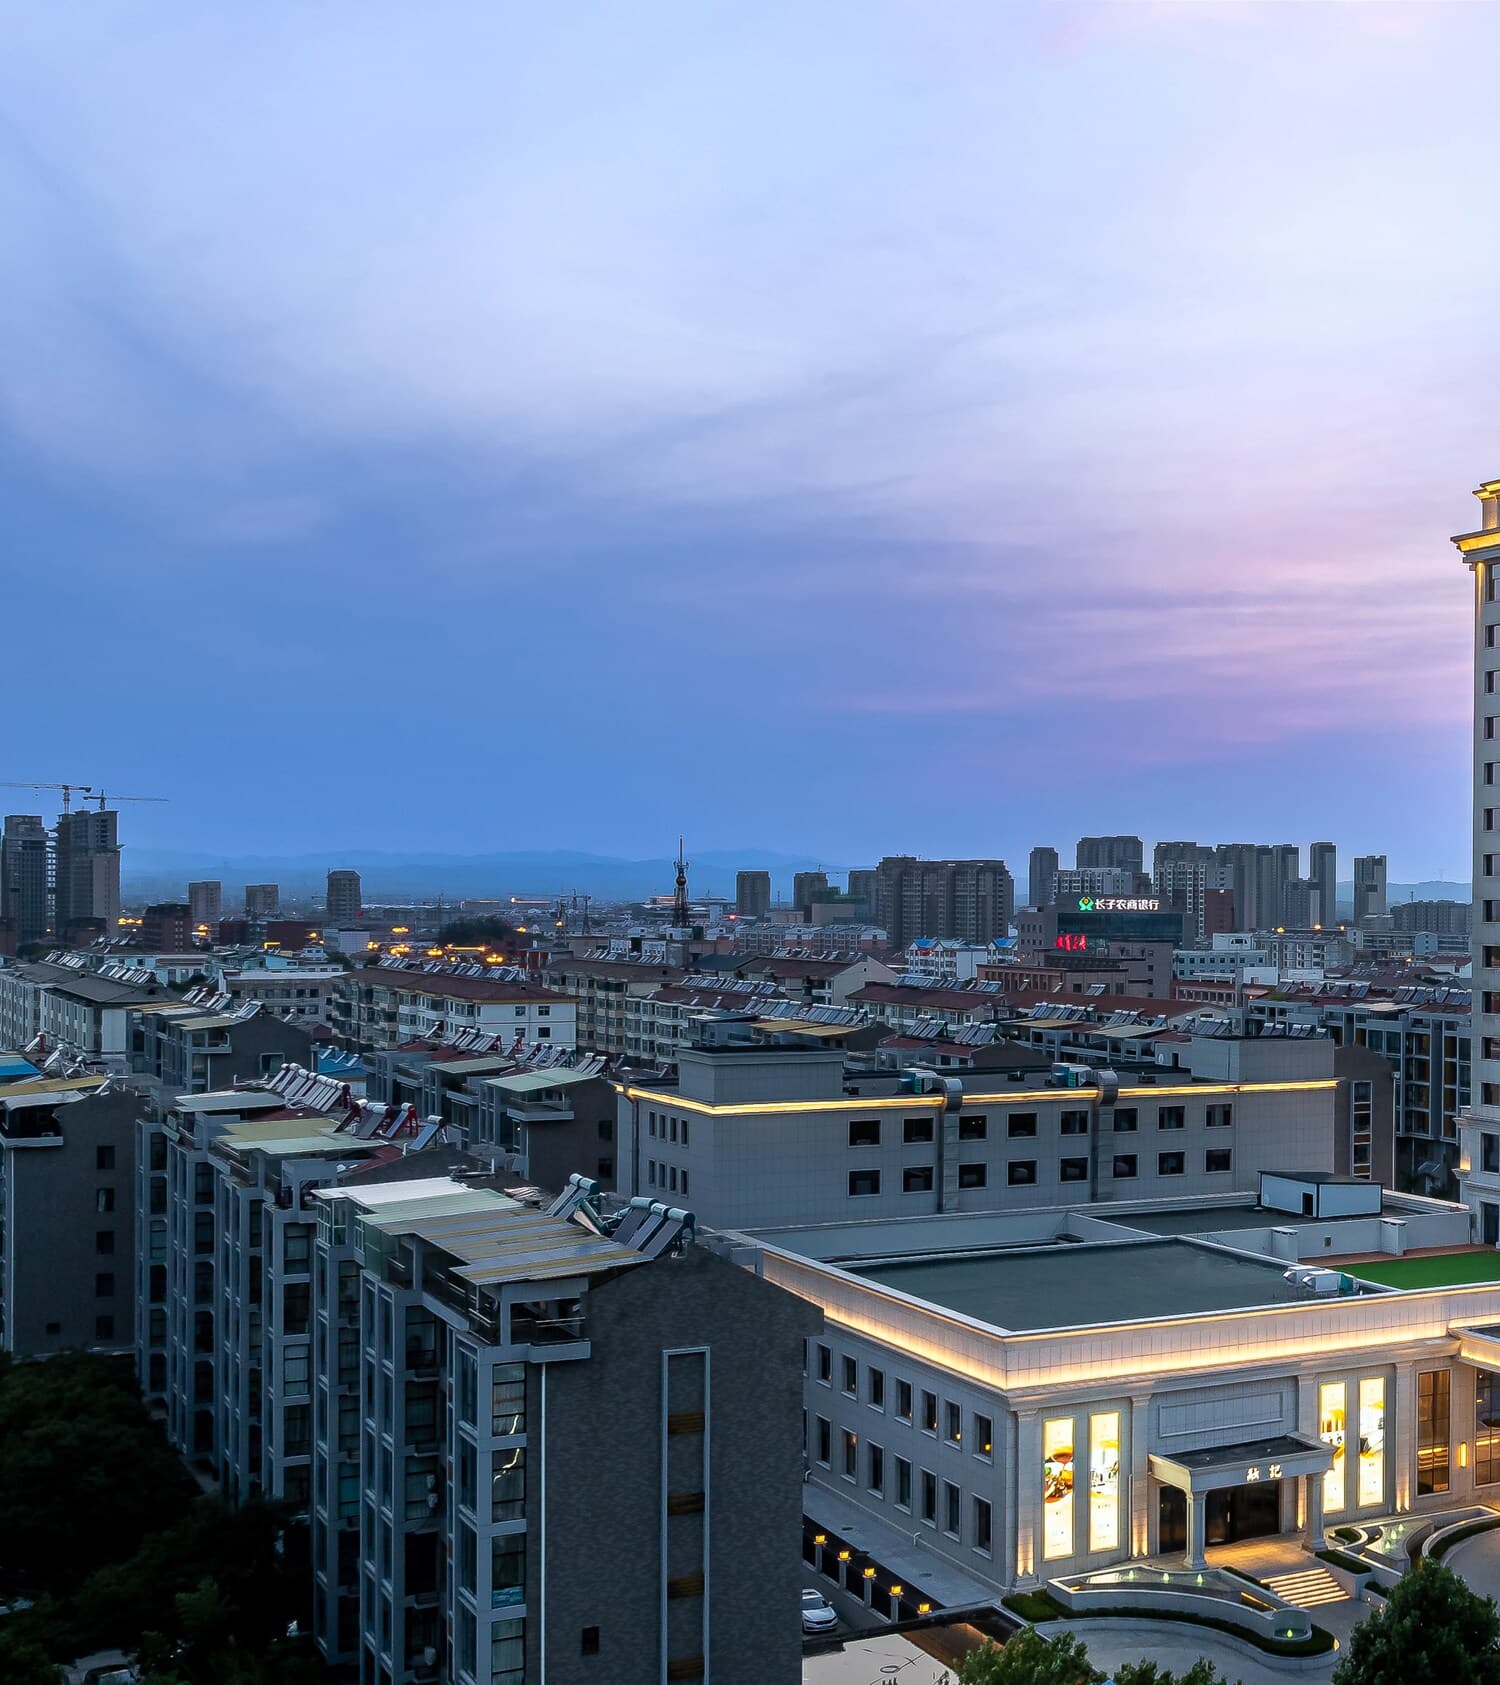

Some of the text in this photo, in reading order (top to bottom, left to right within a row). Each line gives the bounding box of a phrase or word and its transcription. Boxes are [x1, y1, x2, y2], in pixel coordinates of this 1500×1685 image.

[1095, 899, 1160, 911] 长子农商银行
